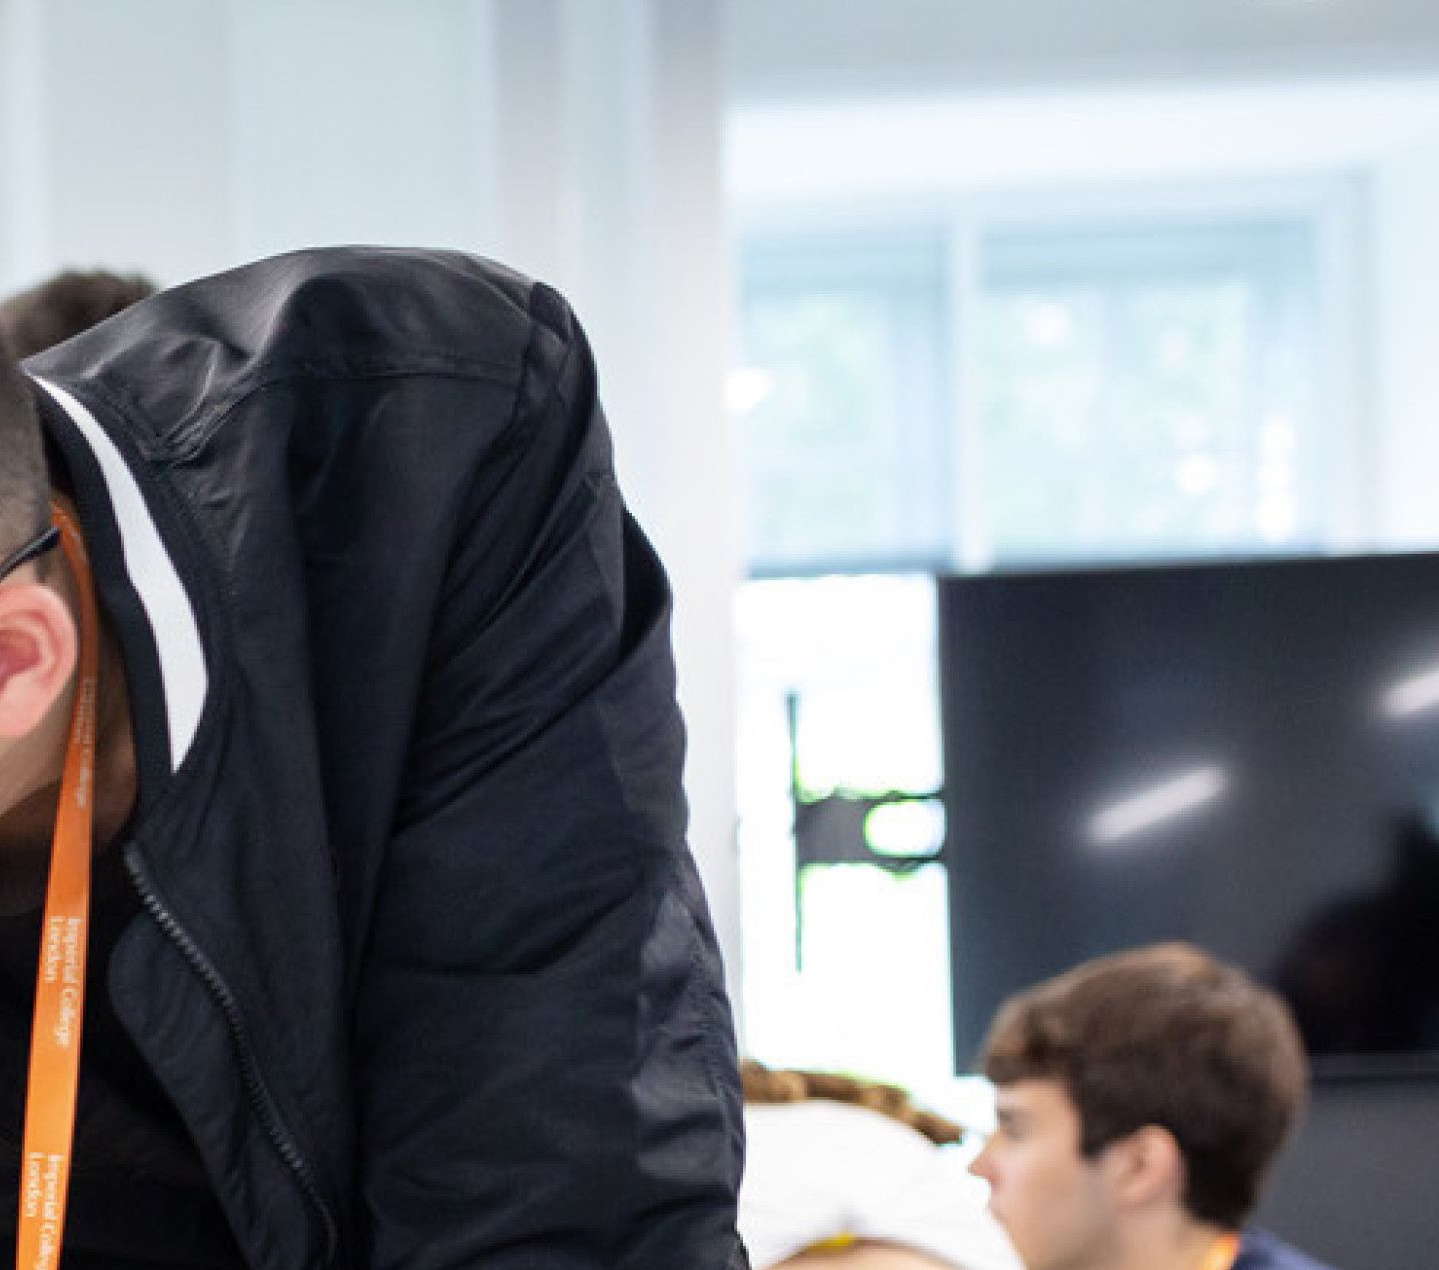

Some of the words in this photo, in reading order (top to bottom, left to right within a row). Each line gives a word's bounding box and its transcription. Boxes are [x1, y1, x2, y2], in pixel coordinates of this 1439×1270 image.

[44, 916, 63, 983] London
[66, 917, 83, 984] Imperial
[54, 987, 75, 1048] College
[25, 1152, 43, 1217] London
[42, 1155, 64, 1220] Imperial
